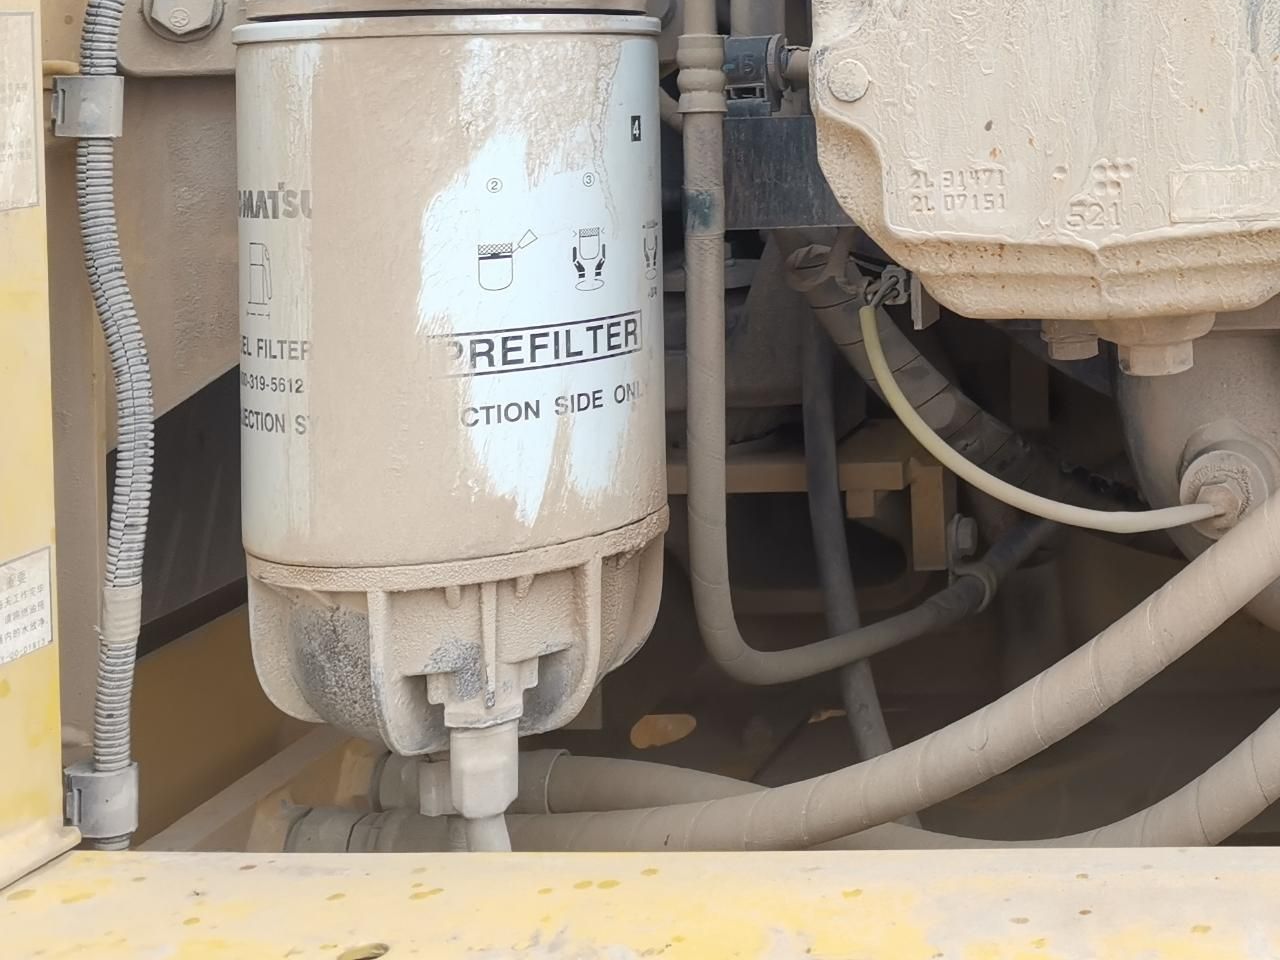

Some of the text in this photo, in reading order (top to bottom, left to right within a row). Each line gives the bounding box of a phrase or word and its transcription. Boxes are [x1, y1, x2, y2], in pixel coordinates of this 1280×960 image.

[239, 189, 312, 220] MATSU
[447, 318, 638, 370] PREFILTER
[555, 389, 604, 417] SIDE
